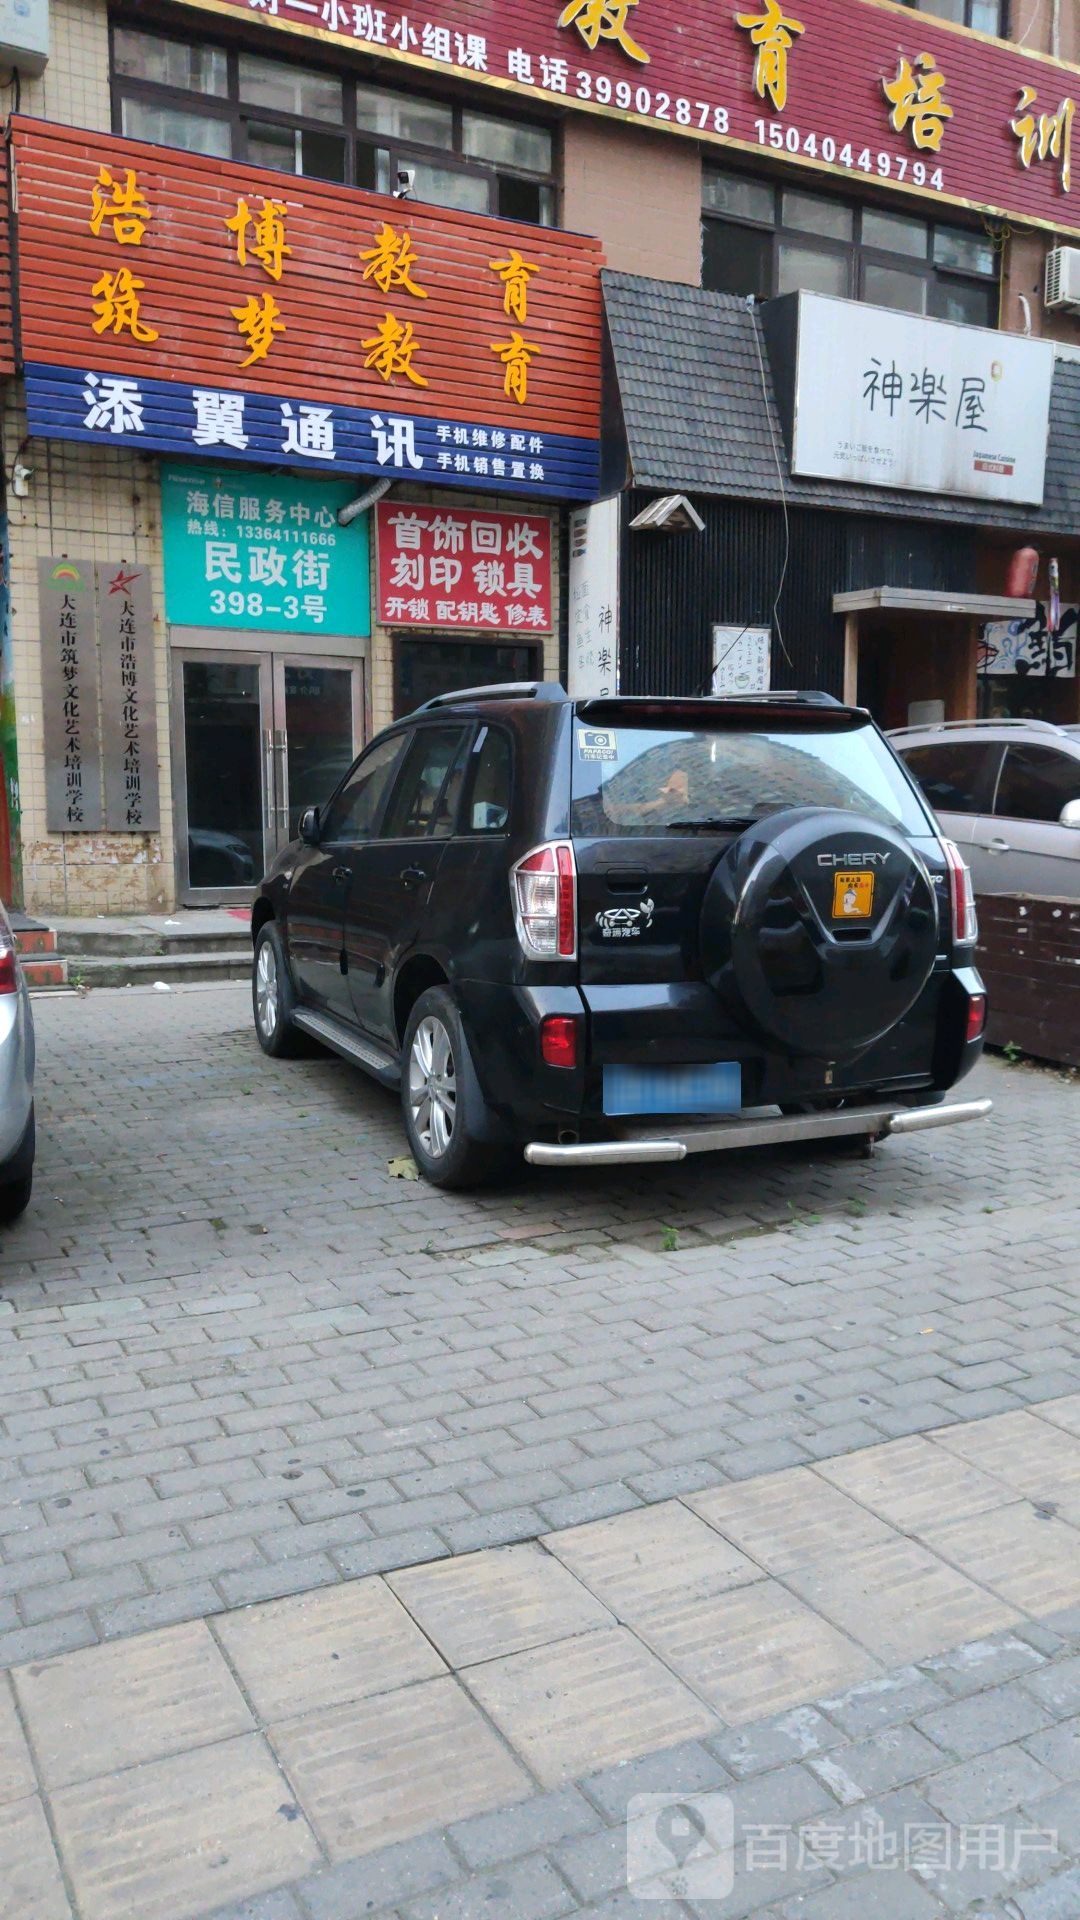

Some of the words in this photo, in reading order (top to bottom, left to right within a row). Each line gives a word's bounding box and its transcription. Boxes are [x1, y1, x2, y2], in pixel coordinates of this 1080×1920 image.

[507, 47, 568, 94] 电话
[576, 71, 729, 134] 39902878
[755, 119, 944, 191] 15040449794
[90, 166, 540, 324] 浩博教育
[91, 267, 541, 404] 筑梦教育
[82, 372, 424, 470] 添翼通讯
[436, 425, 544, 454] 手机维修配件
[437, 452, 544, 480] 手机销售置换
[187, 491, 336, 529] 海信服务中心
[236, 525, 336, 547] 13364111666
[388, 512, 544, 560] 首饰回收
[205, 541, 331, 591] 民政街
[389, 552, 462, 593] 刻印
[471, 559, 543, 599] 锁具
[209, 590, 328, 624] 398-3号
[385, 596, 430, 621] 开锁
[435, 600, 501, 624] 配钥匙
[504, 604, 548, 627] 修表
[59, 594, 83, 823] 大连市筑梦文化艺术培训学校
[119, 600, 141, 825] 大连市浩博文化艺术培训学校
[817, 852, 891, 867] CHERY
